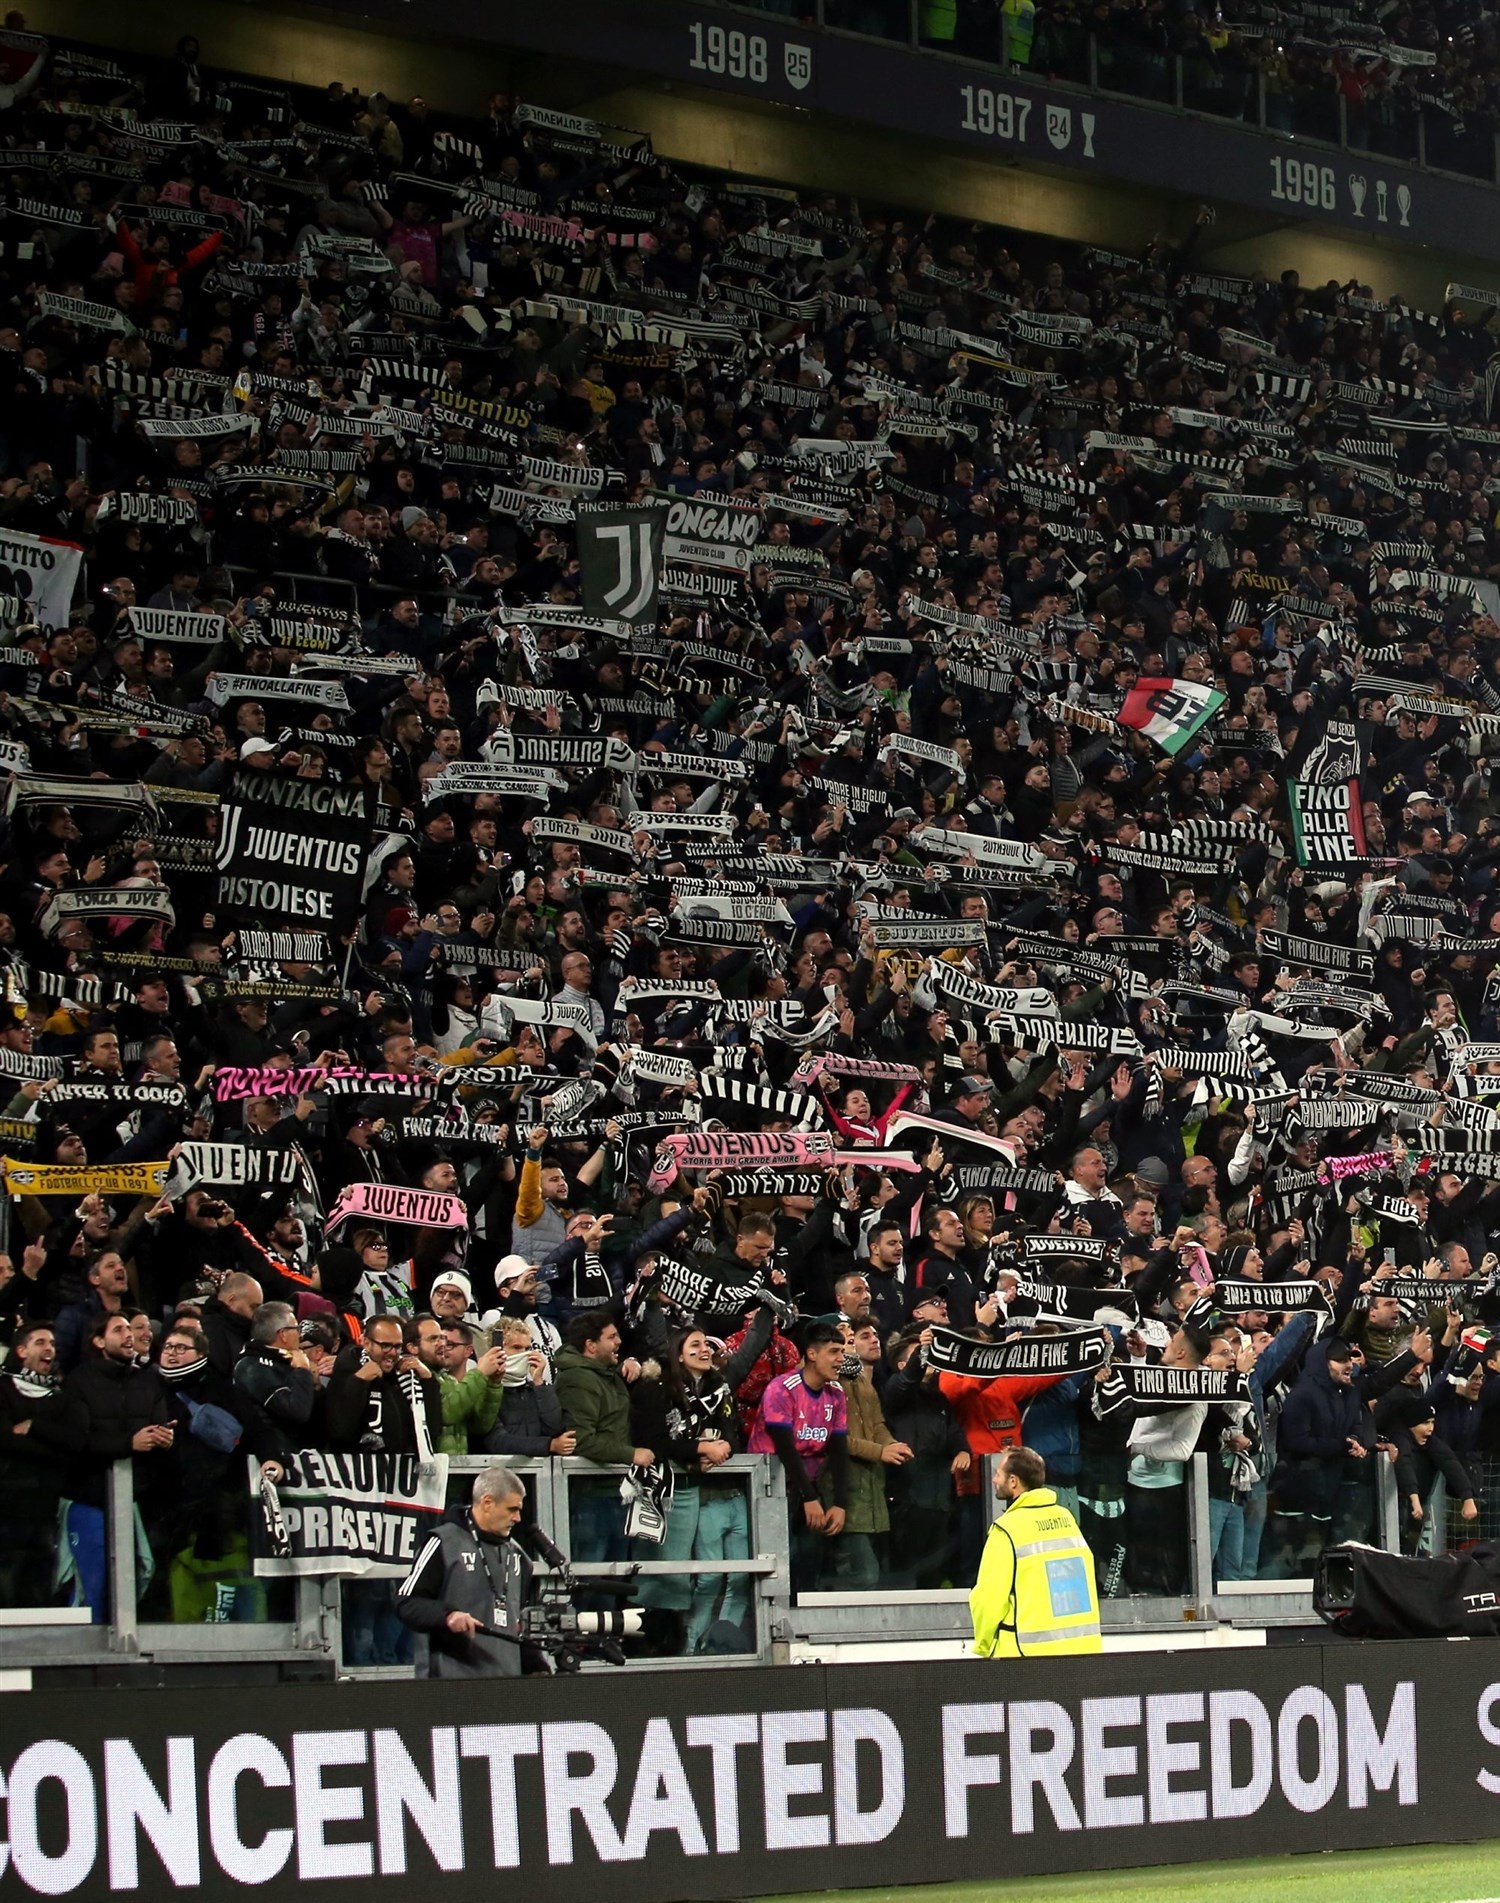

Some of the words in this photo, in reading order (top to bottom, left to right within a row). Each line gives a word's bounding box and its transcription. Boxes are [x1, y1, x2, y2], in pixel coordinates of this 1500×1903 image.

[689, 22, 768, 83] 1998
[788, 52, 808, 79] 25
[960, 85, 1031, 143] 1997
[1050, 116, 1068, 139] 24
[1270, 156, 1335, 210] 1996
[1016, 324, 1063, 346] JUVENTUS
[253, 371, 307, 392] JUVENTUS
[1338, 382, 1380, 405] JUVENTUS
[431, 390, 531, 428] JUVENTUS
[943, 386, 990, 408] JUVENTUS
[991, 396, 1003, 410] FC
[432, 408, 477, 430] SOLO
[480, 423, 519, 447] JUVE
[525, 457, 600, 487] JUVENTUS
[121, 492, 196, 525] JUVENTUS
[578, 501, 620, 513] FINCHE'
[666, 506, 759, 545] ONGANO
[679, 544, 709, 557] JUVENTUS
[710, 549, 726, 560] CLUB
[135, 612, 219, 639] JUVENTUS
[271, 618, 341, 642] JUVENTUS
[868, 638, 901, 652] JUVENTUS
[233, 678, 321, 698] #FINOALLAFINE
[112, 693, 151, 716] FORZA
[164, 710, 194, 729] JUVE
[232, 772, 366, 819] MONTAGNA
[813, 776, 822, 789] DI
[824, 778, 850, 798] PADRE
[852, 785, 860, 799] IN
[861, 788, 887, 804] FIGLIO
[828, 792, 850, 808] SINCE
[852, 799, 869, 813] 1897
[1295, 785, 1350, 810] FINO
[1302, 812, 1347, 833] ALLA
[244, 826, 361, 875] JUVENTUS
[590, 827, 626, 849] JUVE
[1301, 836, 1357, 862] FINE
[715, 856, 806, 874] JUVENTUS
[76, 892, 119, 907] FORZA
[126, 893, 161, 906] JUVE
[217, 876, 334, 920] PISTOIESE
[891, 925, 965, 940] JUVENTUS
[1443, 937, 1500, 951] JUVENTUS
[241, 931, 270, 961] BLACK
[272, 933, 291, 960] AND
[293, 934, 323, 962] WHITE
[1019, 941, 1064, 959] JUVENTUS
[1288, 941, 1308, 958] FINO
[1311, 944, 1331, 964] ALLA
[1333, 949, 1350, 969] FINE
[557, 1005, 593, 1033] JUVENTUS
[635, 1050, 682, 1076] JUVENTUS
[53, 1084, 107, 1102] INTER
[112, 1085, 130, 1102] TI
[135, 1086, 184, 1105] ODIO
[403, 1116, 432, 1137] FINO
[434, 1119, 469, 1142] ALLA
[687, 1134, 797, 1155] JUVENTUS
[682, 1156, 713, 1166] STORIA
[715, 1156, 724, 1165] DI
[727, 1156, 738, 1165] UN
[740, 1156, 770, 1165] GRANDE
[772, 1155, 800, 1164] AMORE
[40, 1177, 90, 1190] FOOTBALL
[92, 1178, 119, 1190] CLUB
[122, 1179, 148, 1190] 1897
[726, 1173, 822, 1198] JUVENTUS
[959, 1167, 988, 1190] FINO
[990, 1168, 1021, 1190] ALLA
[1023, 1173, 1054, 1193] FINE
[362, 1186, 454, 1223] JUVENTUS
[1029, 1237, 1103, 1257] JUVENTUS
[660, 1274, 703, 1311] SINCE
[969, 1347, 1002, 1370] FINO
[1005, 1345, 1036, 1368] ALLA
[1041, 1341, 1069, 1368] FINE
[1134, 1368, 1164, 1394] FINO
[1167, 1369, 1196, 1395] ALLA
[1201, 1370, 1229, 1395] FINE
[797, 1424, 828, 1442] Jeep
[461, 1552, 477, 1563] TV
[0, 1709, 905, 1895] ONCENTRATED
[943, 1682, 1419, 1839] FREEDOM
